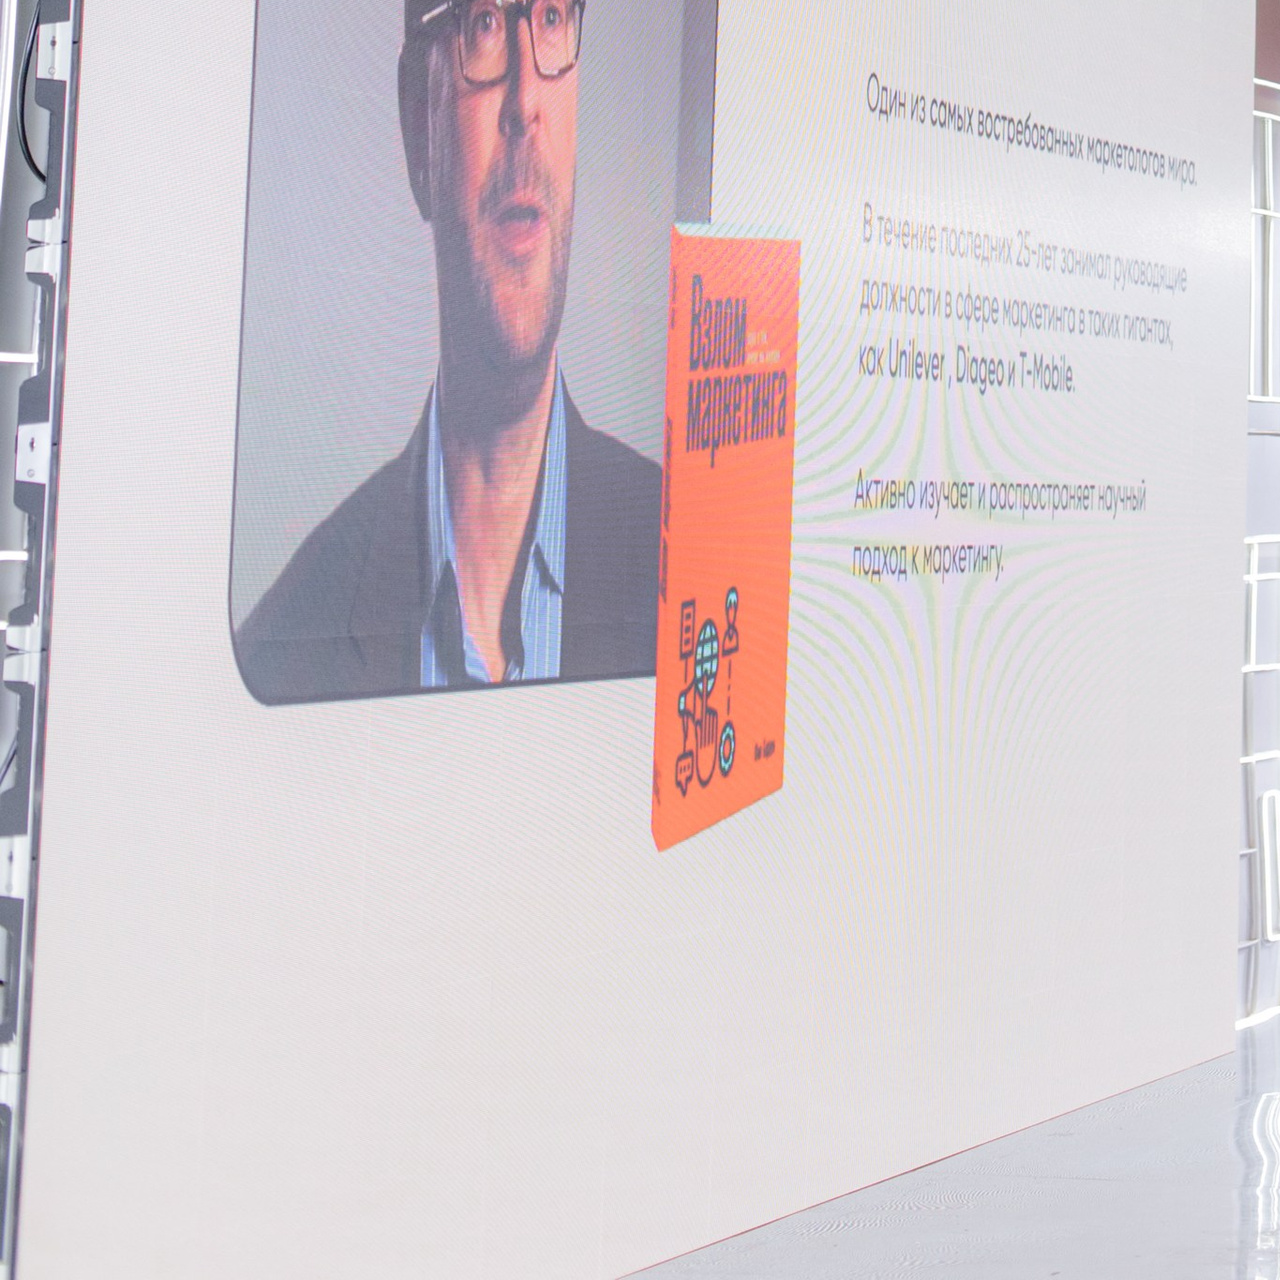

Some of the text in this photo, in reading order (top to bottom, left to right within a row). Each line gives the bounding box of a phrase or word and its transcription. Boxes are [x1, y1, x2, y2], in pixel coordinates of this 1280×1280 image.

[866, 72, 1198, 191] Один из самых востребованных маркетологов мира.
[862, 201, 1188, 297] В течение последних 25-лет занимал руководящие
[688, 273, 747, 373] Взлом
[859, 279, 1174, 352] должности в сфере маркетинга в таких гигантах,
[858, 343, 885, 377] как
[888, 338, 945, 381] Unilever
[956, 344, 1005, 395] Diageo
[1007, 357, 1016, 388] и
[1019, 351, 1076, 393] T-Mobile.
[685, 367, 788, 469] маркетинга
[854, 467, 1147, 521] Активно изучает и распространяет научный
[852, 543, 1005, 584] подход к маркетингу.
